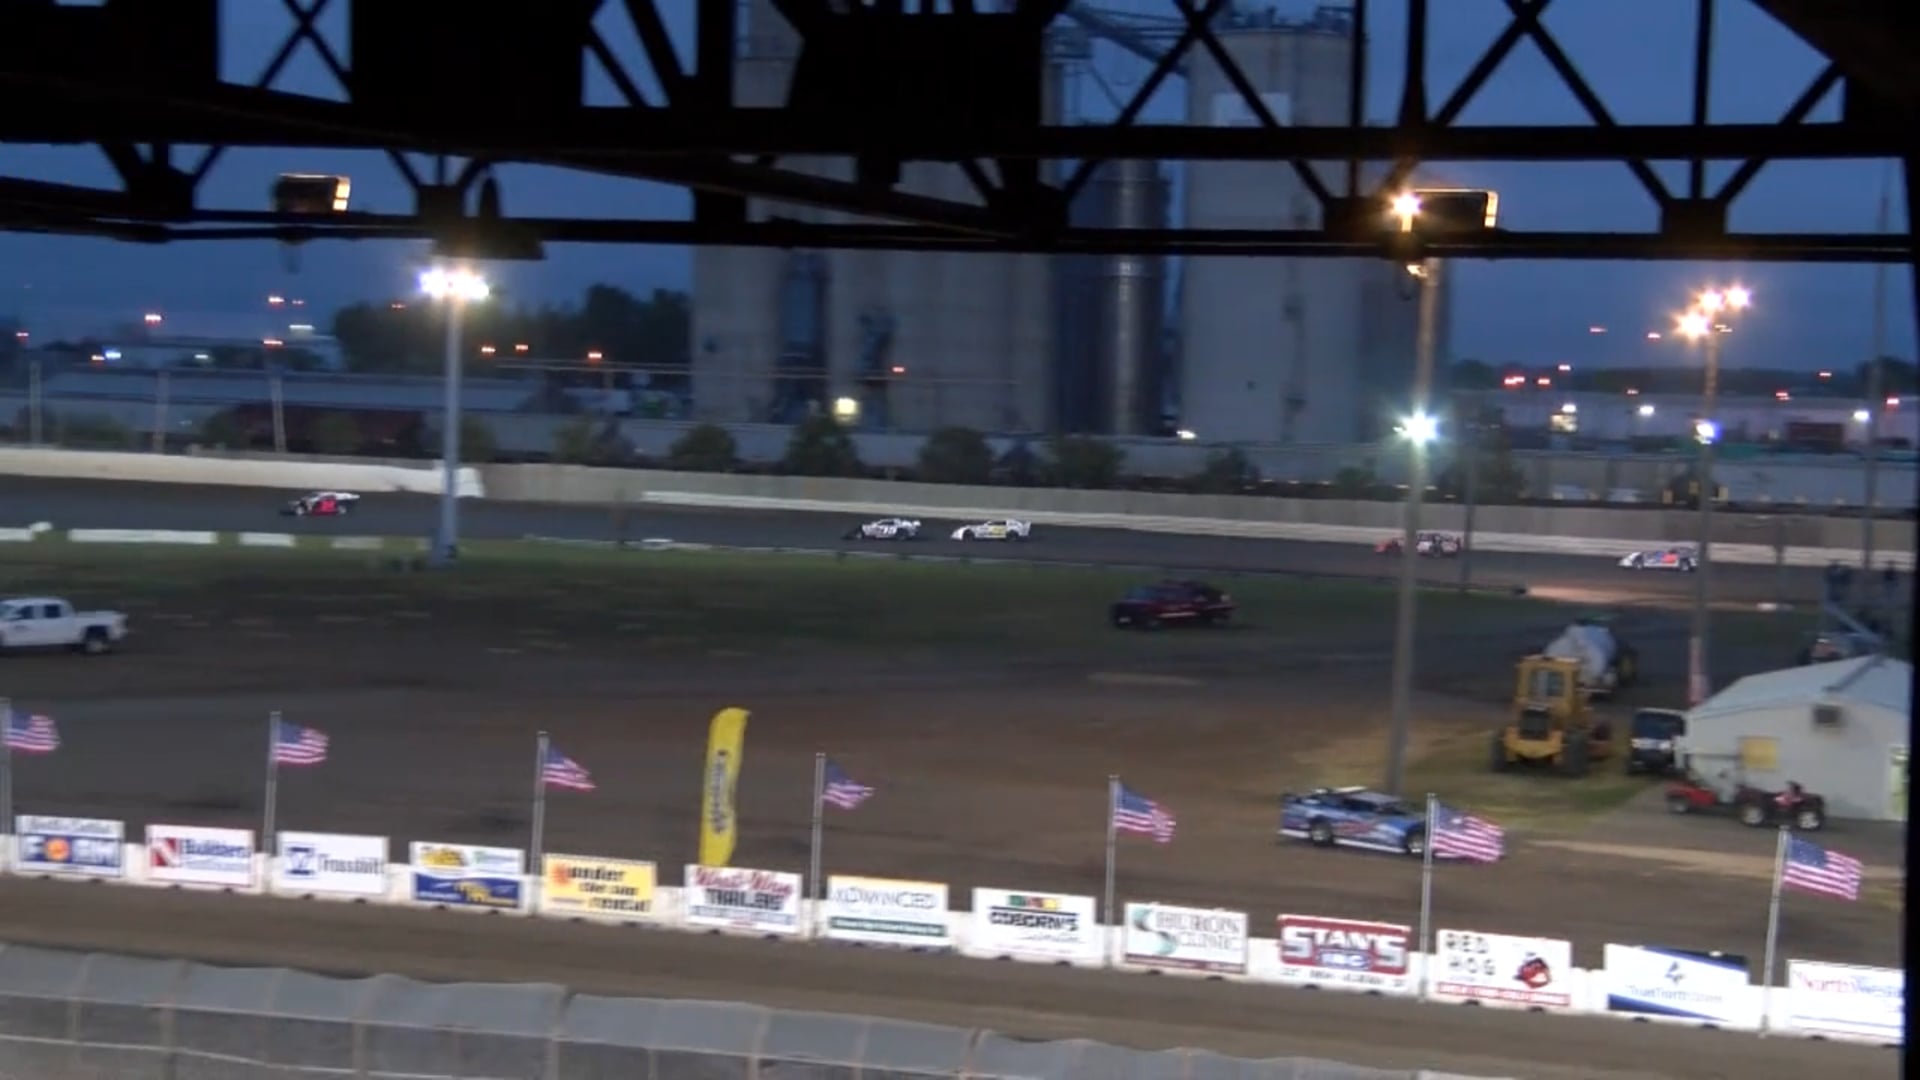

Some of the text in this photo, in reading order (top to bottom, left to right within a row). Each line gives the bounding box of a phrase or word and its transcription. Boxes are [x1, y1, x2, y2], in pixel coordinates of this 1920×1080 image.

[1280, 925, 1407, 967] STAN'S
[1445, 932, 1489, 954] RED
[1448, 955, 1497, 976] HOG
